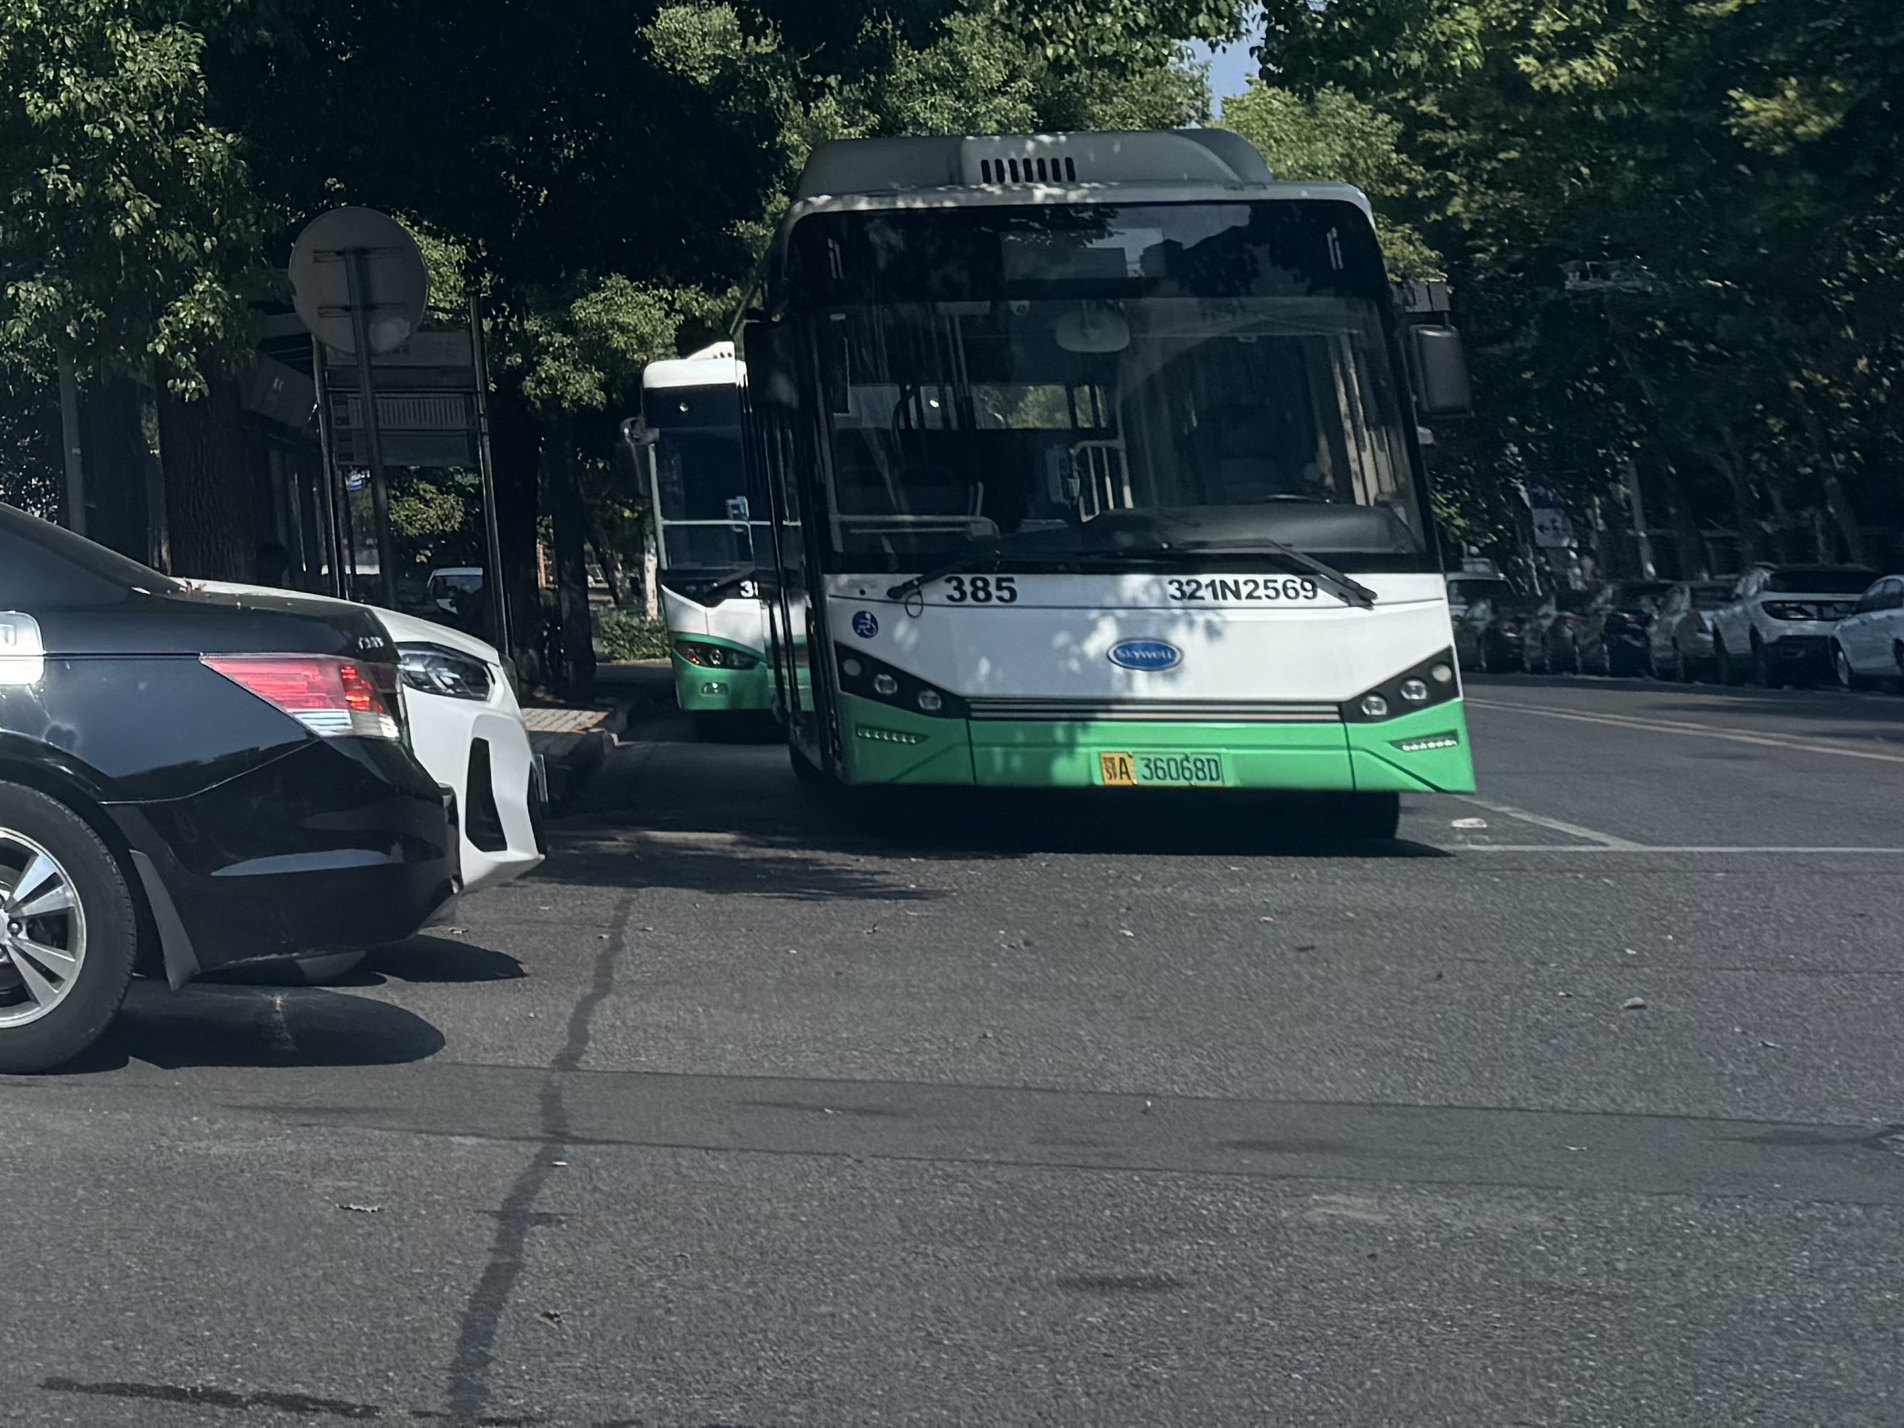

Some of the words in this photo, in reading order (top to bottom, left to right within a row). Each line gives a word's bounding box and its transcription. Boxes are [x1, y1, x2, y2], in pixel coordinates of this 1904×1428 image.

[739, 580, 759, 598] 3
[944, 575, 1018, 604] 385
[1167, 578, 1319, 602] 321N2569
[1139, 756, 1221, 782] 36068D
